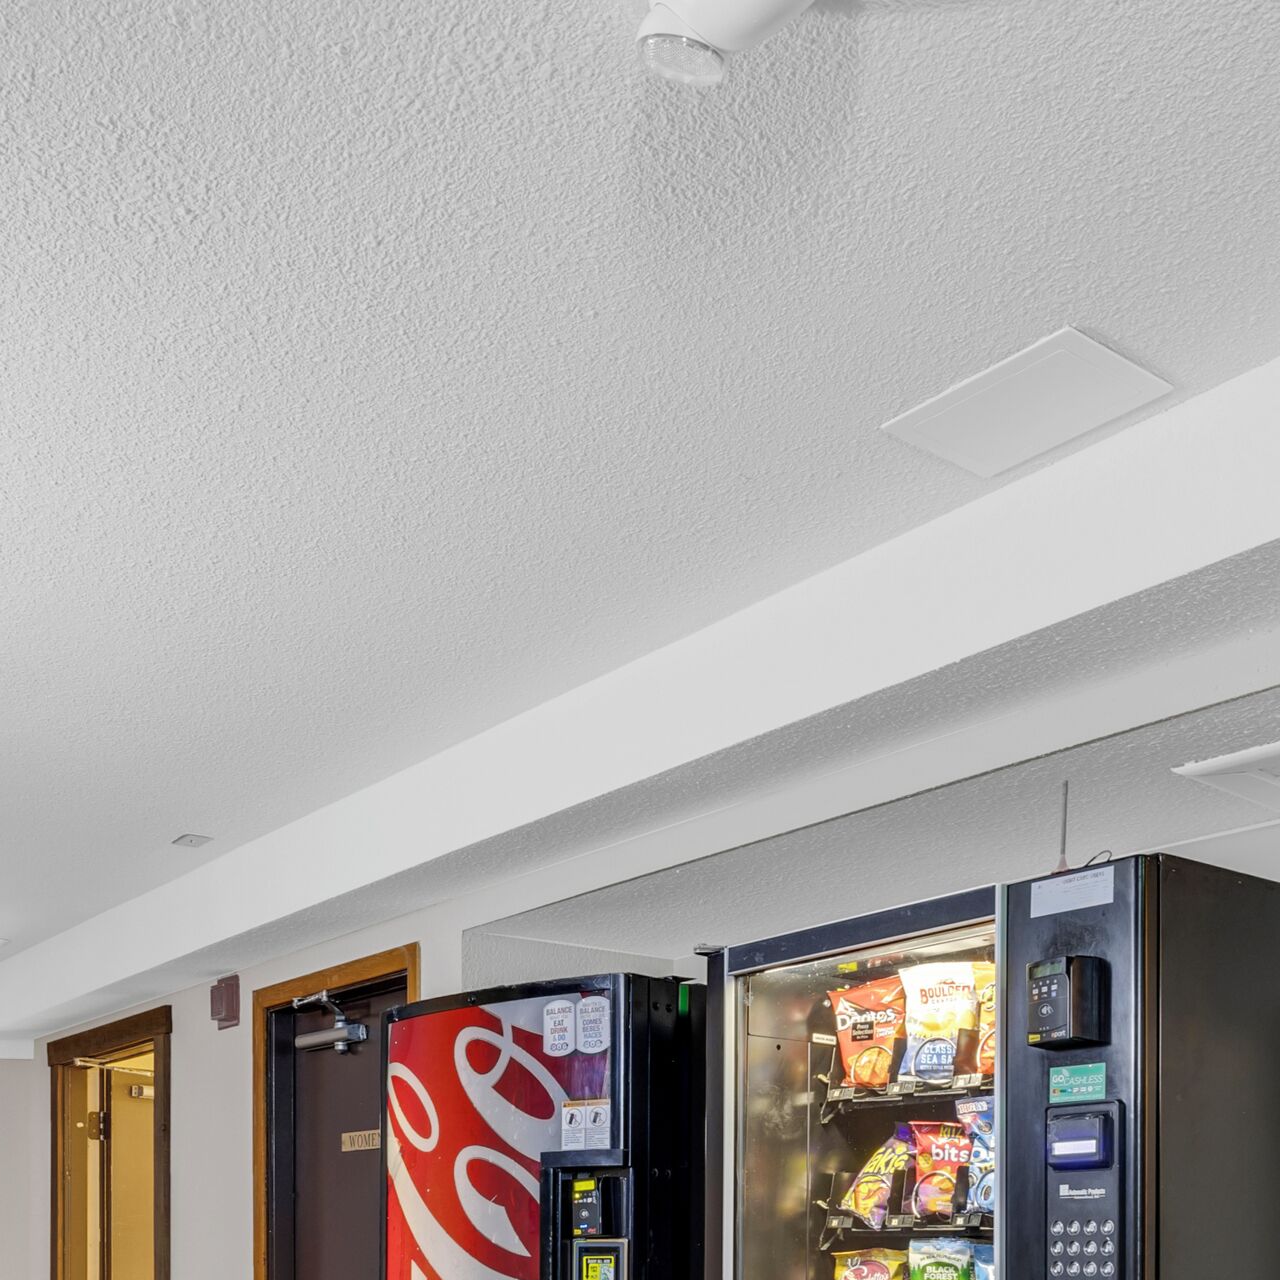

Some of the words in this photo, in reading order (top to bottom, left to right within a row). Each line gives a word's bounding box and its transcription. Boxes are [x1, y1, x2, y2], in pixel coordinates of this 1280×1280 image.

[546, 1006, 573, 1016] BALANCE
[553, 1019, 564, 1027] EAT
[550, 1026, 568, 1034] DRINK
[557, 1033, 566, 1041] DO
[924, 1043, 956, 1055] CLASS
[921, 1054, 938, 1064] SEA
[941, 1054, 953, 1064] SA
[1052, 1074, 1065, 1083] GO
[931, 1142, 970, 1163] bits
[926, 1265, 956, 1274] BLACK
[923, 1273, 958, 1280] FOREST
